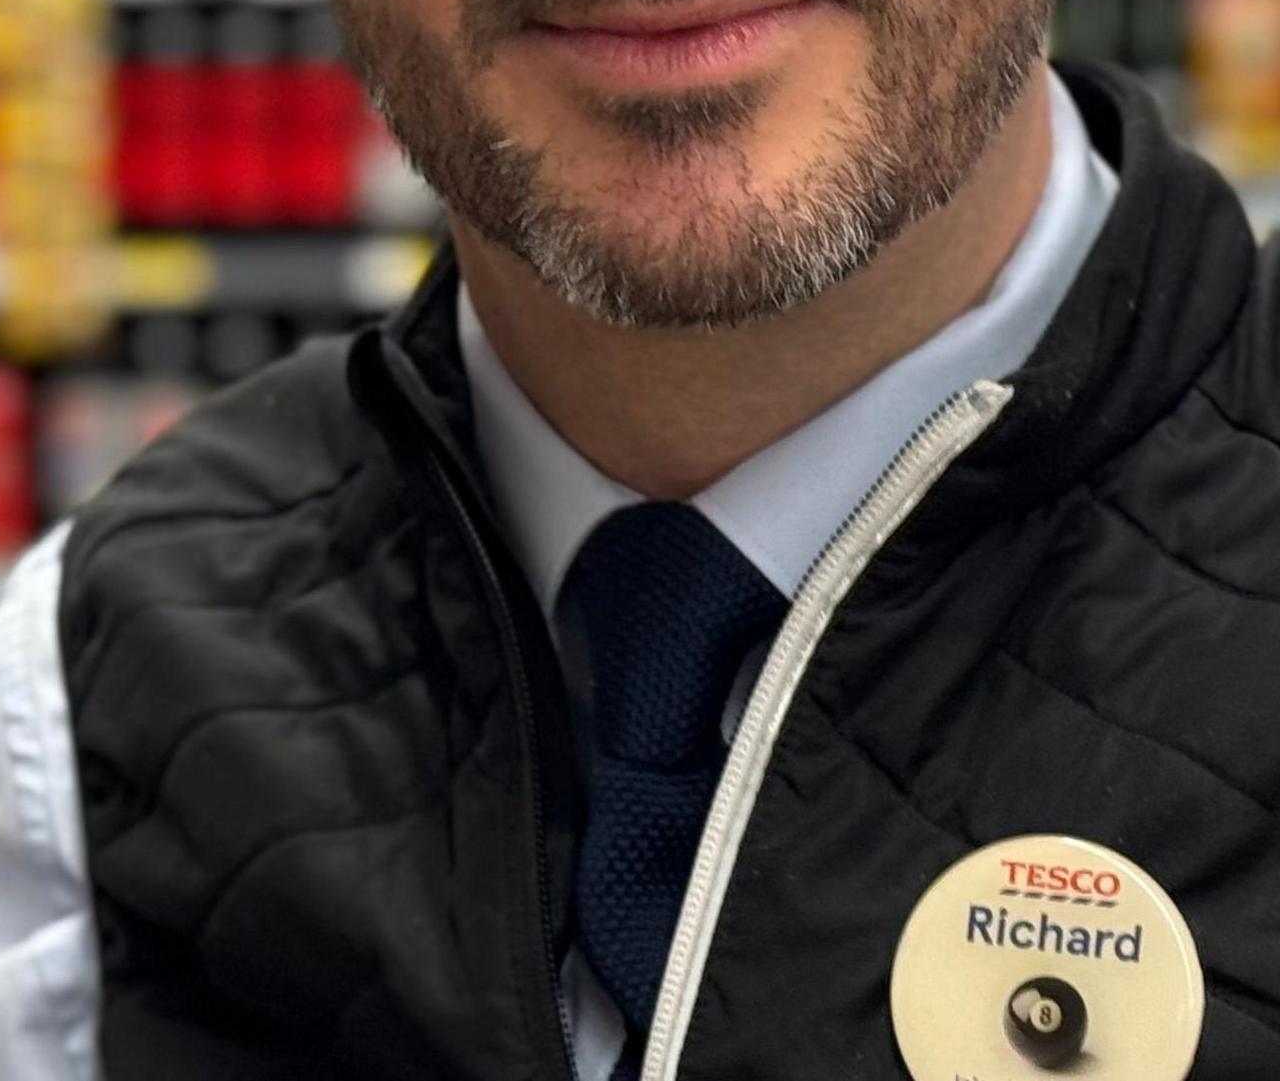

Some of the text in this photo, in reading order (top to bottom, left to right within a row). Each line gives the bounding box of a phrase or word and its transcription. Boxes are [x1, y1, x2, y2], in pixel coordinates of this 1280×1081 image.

[1001, 858, 1121, 897] TESCO
[966, 904, 1142, 963] Richard
[1039, 1006, 1052, 1026] 8
